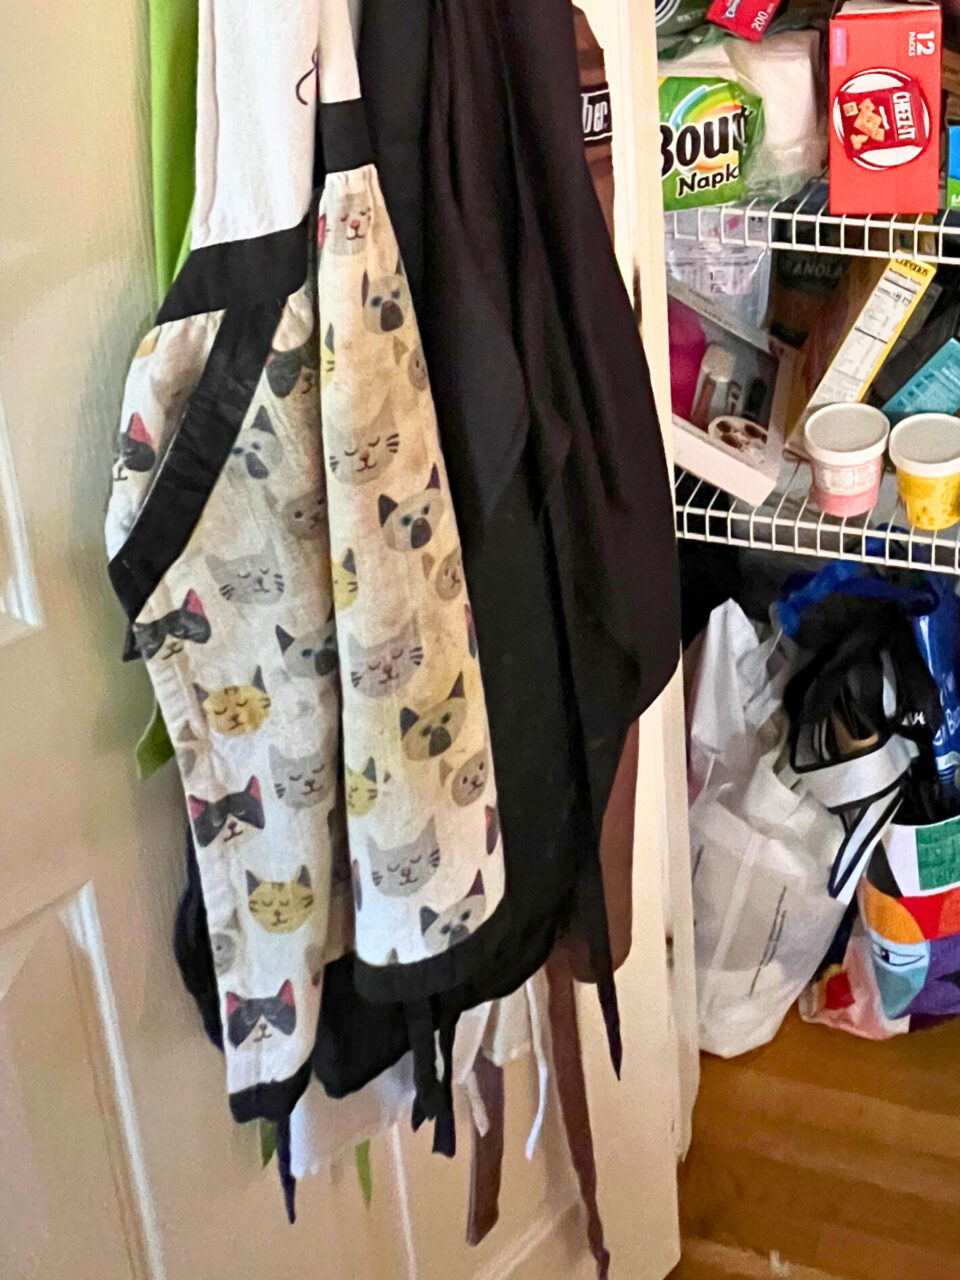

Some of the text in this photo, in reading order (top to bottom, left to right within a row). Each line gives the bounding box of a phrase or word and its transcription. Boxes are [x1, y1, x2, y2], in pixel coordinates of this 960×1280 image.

[751, 10, 769, 32] 200
[916, 30, 936, 56] 12
[582, 95, 609, 132] ber
